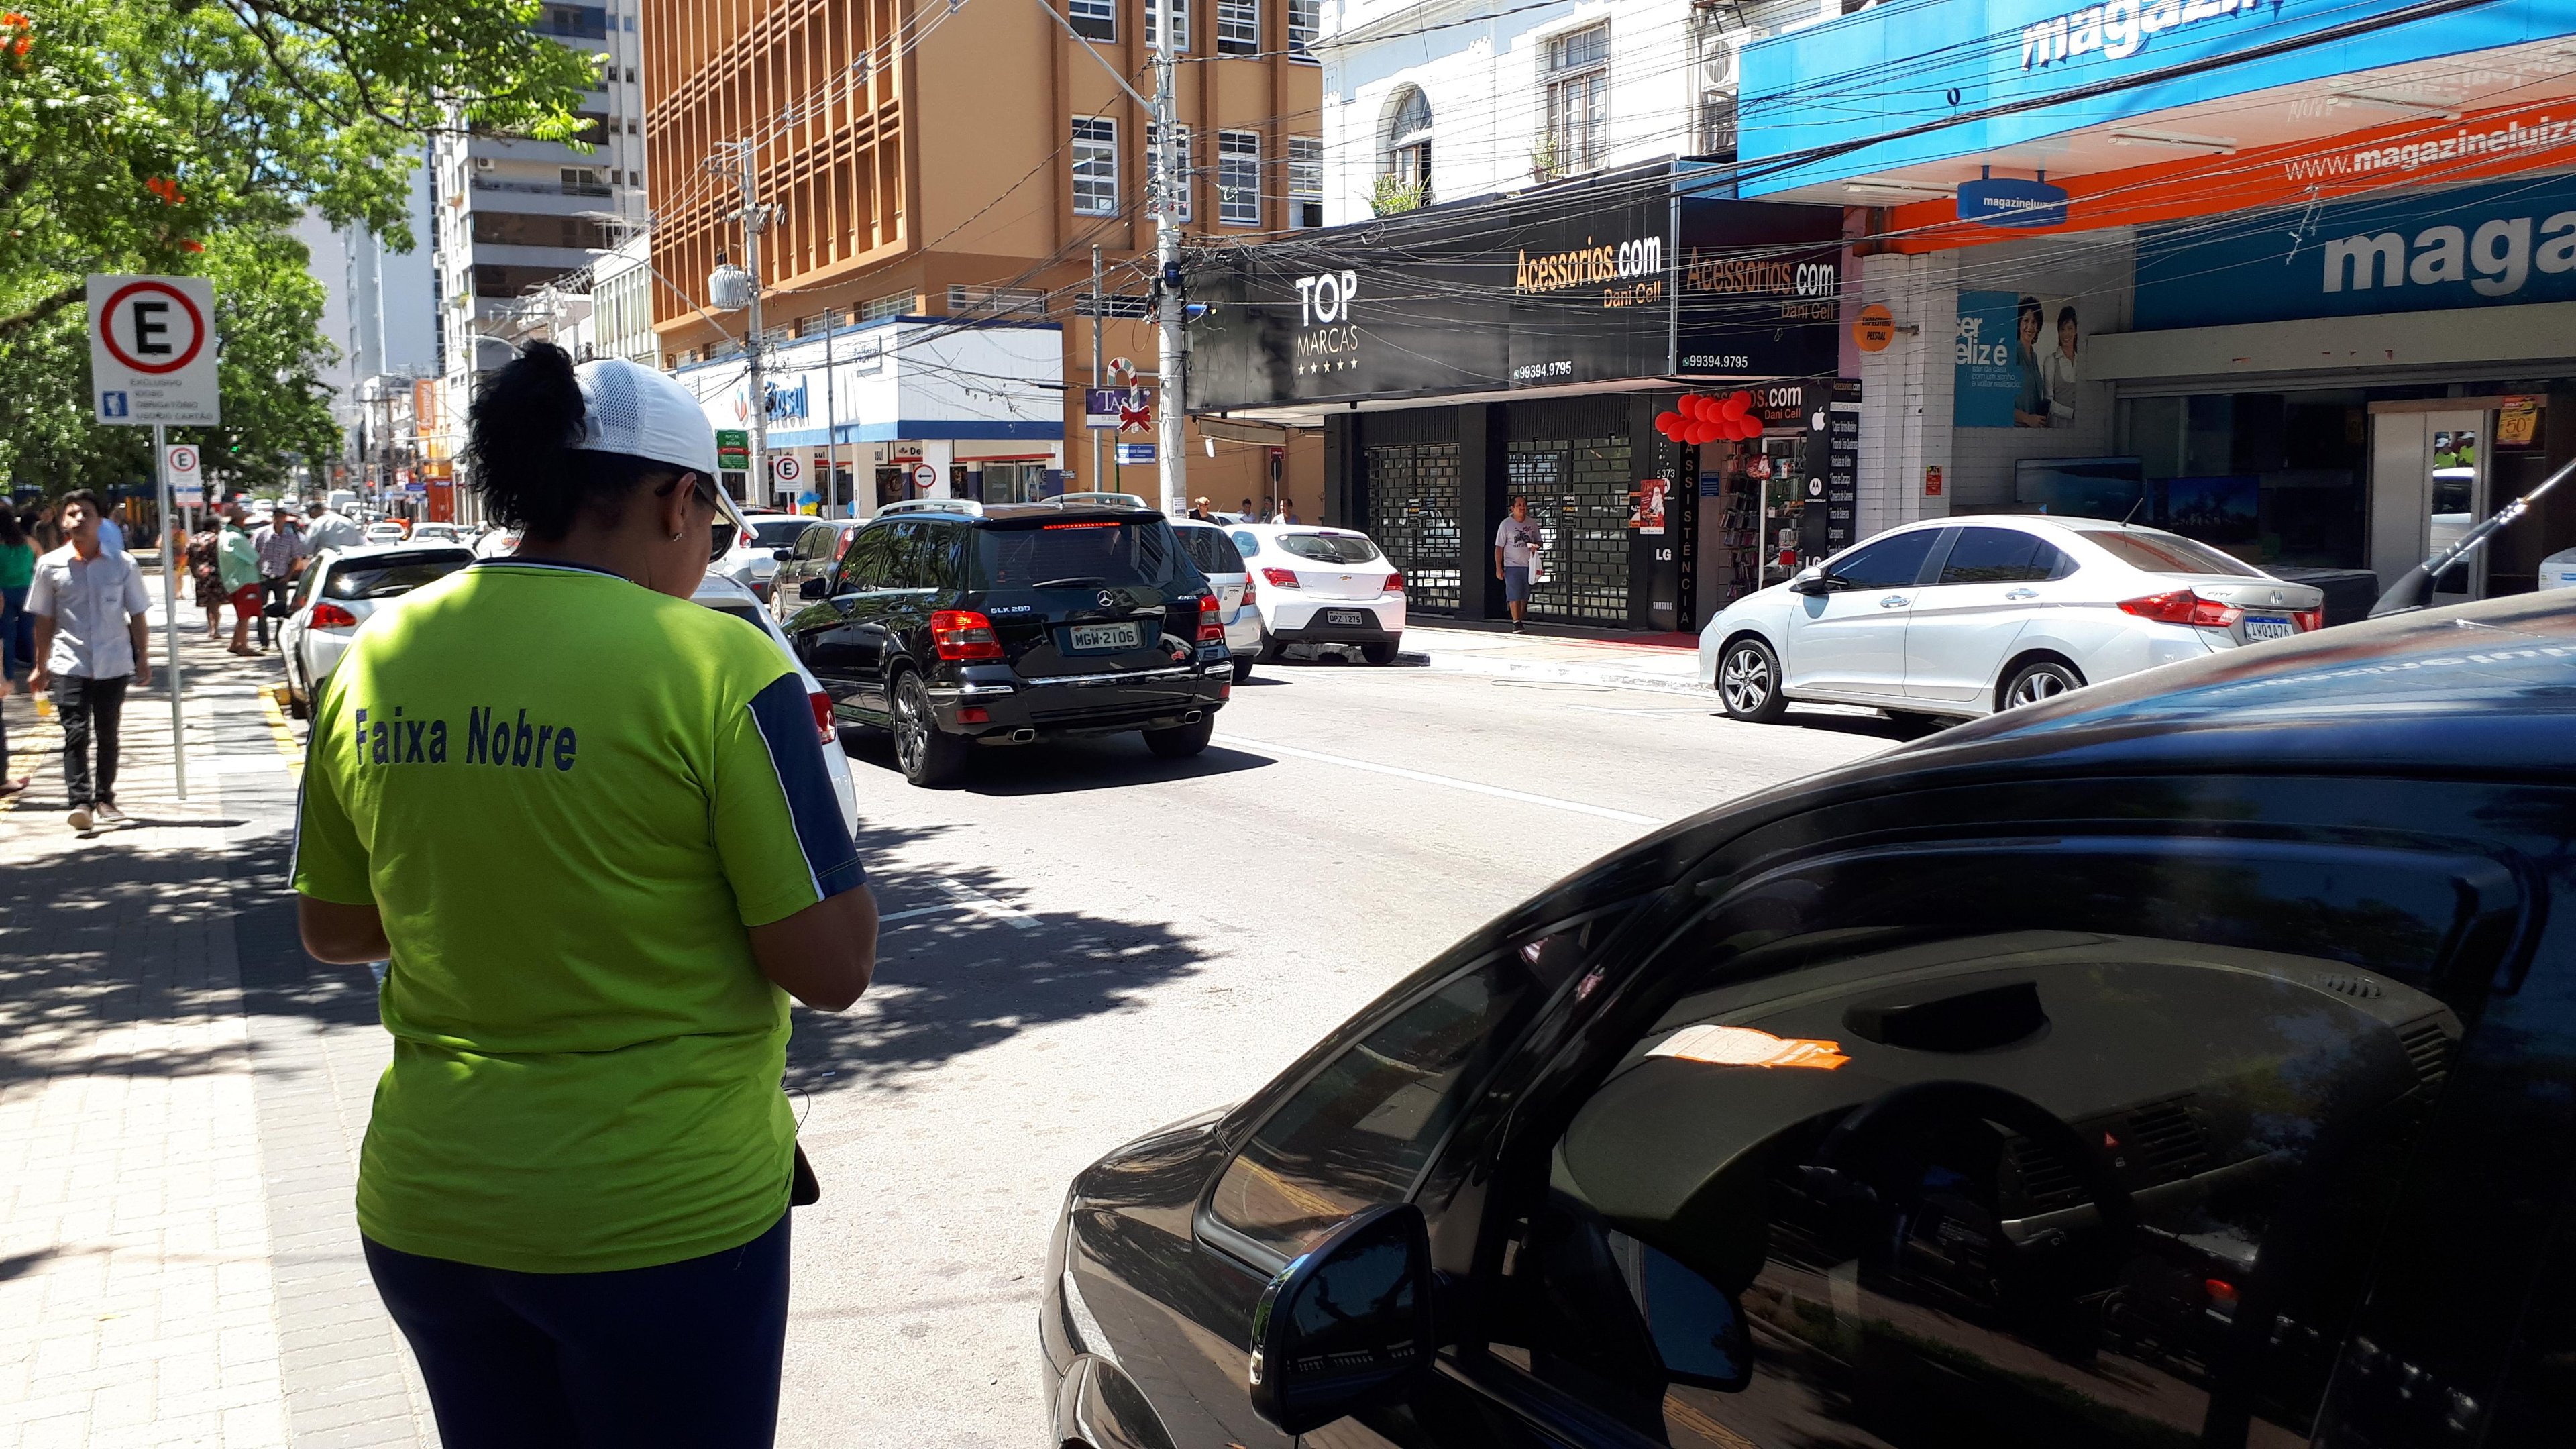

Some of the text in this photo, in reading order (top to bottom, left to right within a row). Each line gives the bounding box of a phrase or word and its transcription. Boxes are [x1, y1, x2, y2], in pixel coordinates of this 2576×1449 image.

[2021, 0, 2266, 72] magaz
[1516, 235, 1661, 295] Acessorios.com
[1686, 246, 1834, 297] Acessorios.com
[1295, 269, 1357, 327] TOP
[1603, 280, 1661, 308] Dani Cell
[1781, 302, 1833, 320] Dani Cell
[133, 301, 172, 354] E
[1866, 331, 1886, 341] PESSOAL
[1297, 325, 1358, 357] MARCAS
[1519, 360, 1572, 379] 99394.9795
[1690, 354, 1748, 368] 99394.9795
[130, 378, 182, 386] EXCLUSIVO
[1764, 407, 1801, 420] Dani Cell
[178, 452, 189, 467] E
[784, 462, 793, 476] E
[1656, 468, 1676, 478] 5373
[1680, 445, 1694, 624] ASSISTÊNCIA
[1656, 548, 1672, 561] LG
[1652, 601, 1672, 610] SAMSUNG
[356, 706, 577, 771] Faixa Nobre
